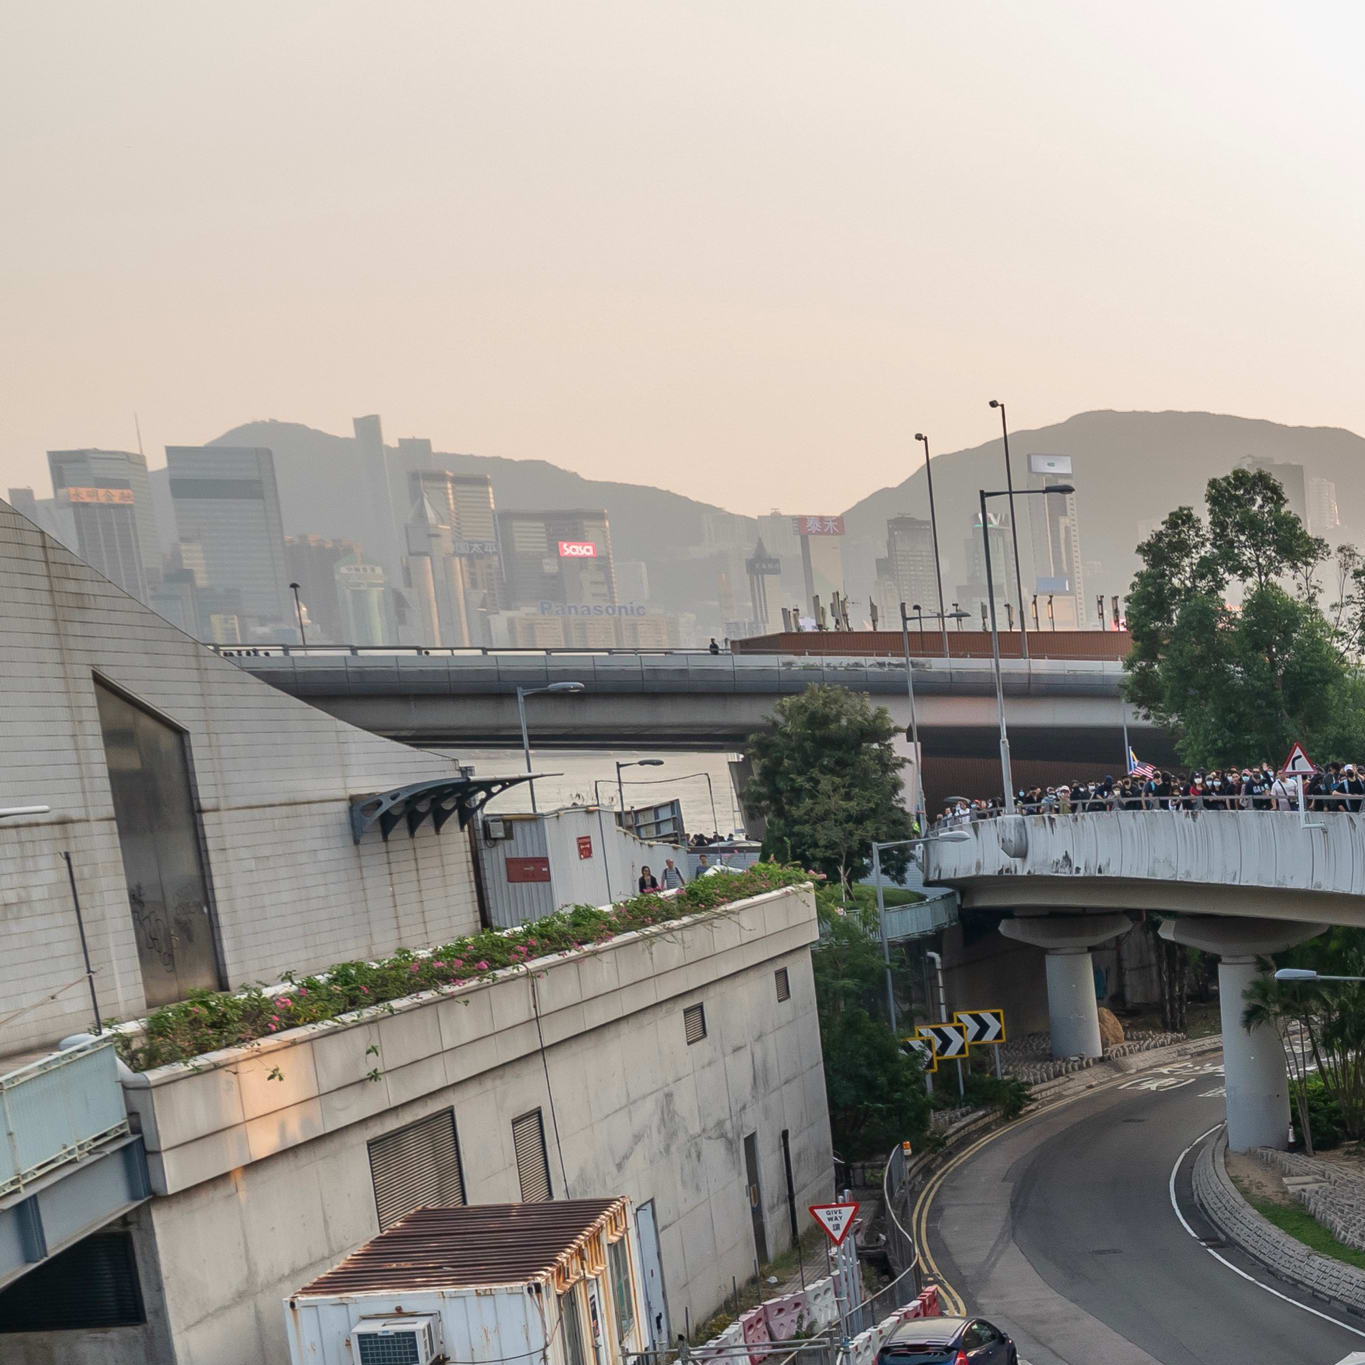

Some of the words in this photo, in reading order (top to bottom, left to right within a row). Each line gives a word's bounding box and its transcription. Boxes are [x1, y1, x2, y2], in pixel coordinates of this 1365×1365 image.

[808, 517, 840, 534] 泰禾
[563, 543, 594, 556] Sasa
[539, 599, 646, 618] Panasonic
